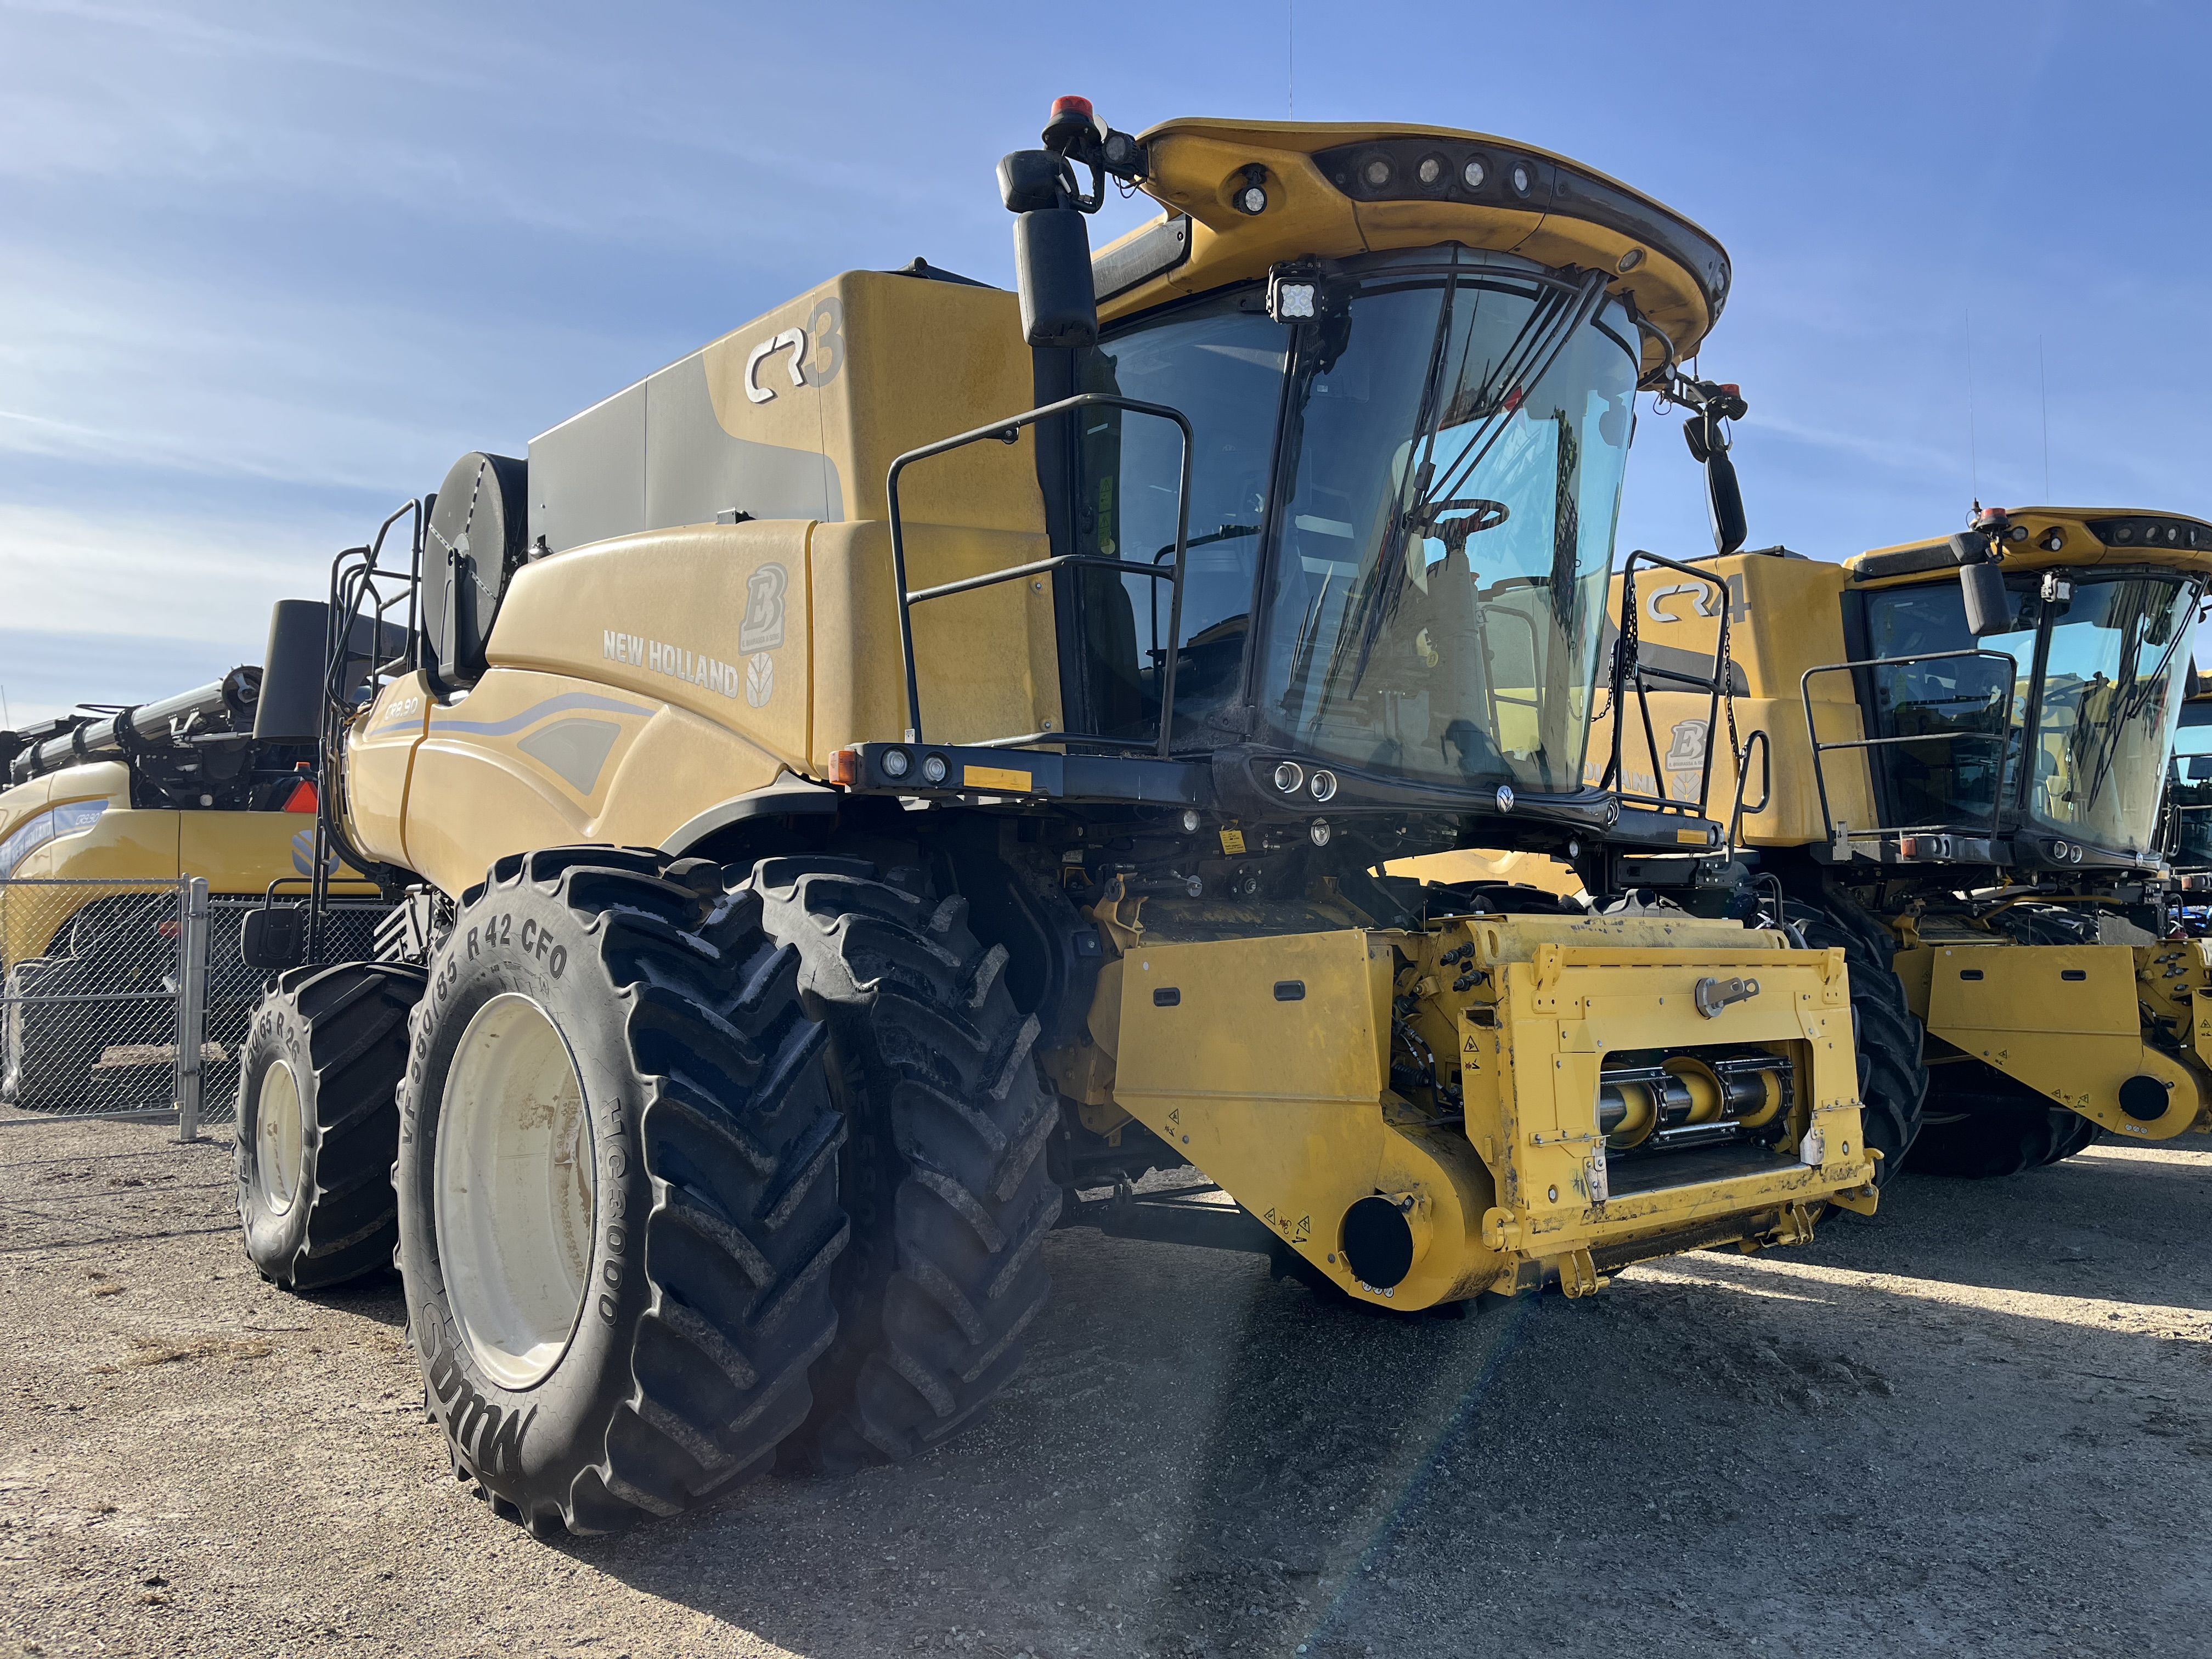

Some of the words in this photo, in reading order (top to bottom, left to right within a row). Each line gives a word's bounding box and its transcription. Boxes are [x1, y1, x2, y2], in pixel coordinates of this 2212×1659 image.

[744, 296, 845, 404] CR3
[603, 629, 644, 667] NEW
[649, 640, 739, 699] HOLLAND
[384, 696, 419, 721] CR8.90
[24, 821, 52, 853] HOLLAND
[411, 951, 457, 1085] 580/85
[467, 926, 480, 962] R
[485, 913, 512, 948] 42
[521, 918, 567, 980] CFO
[276, 1011, 285, 1040] R
[286, 1026, 300, 1064] 26
